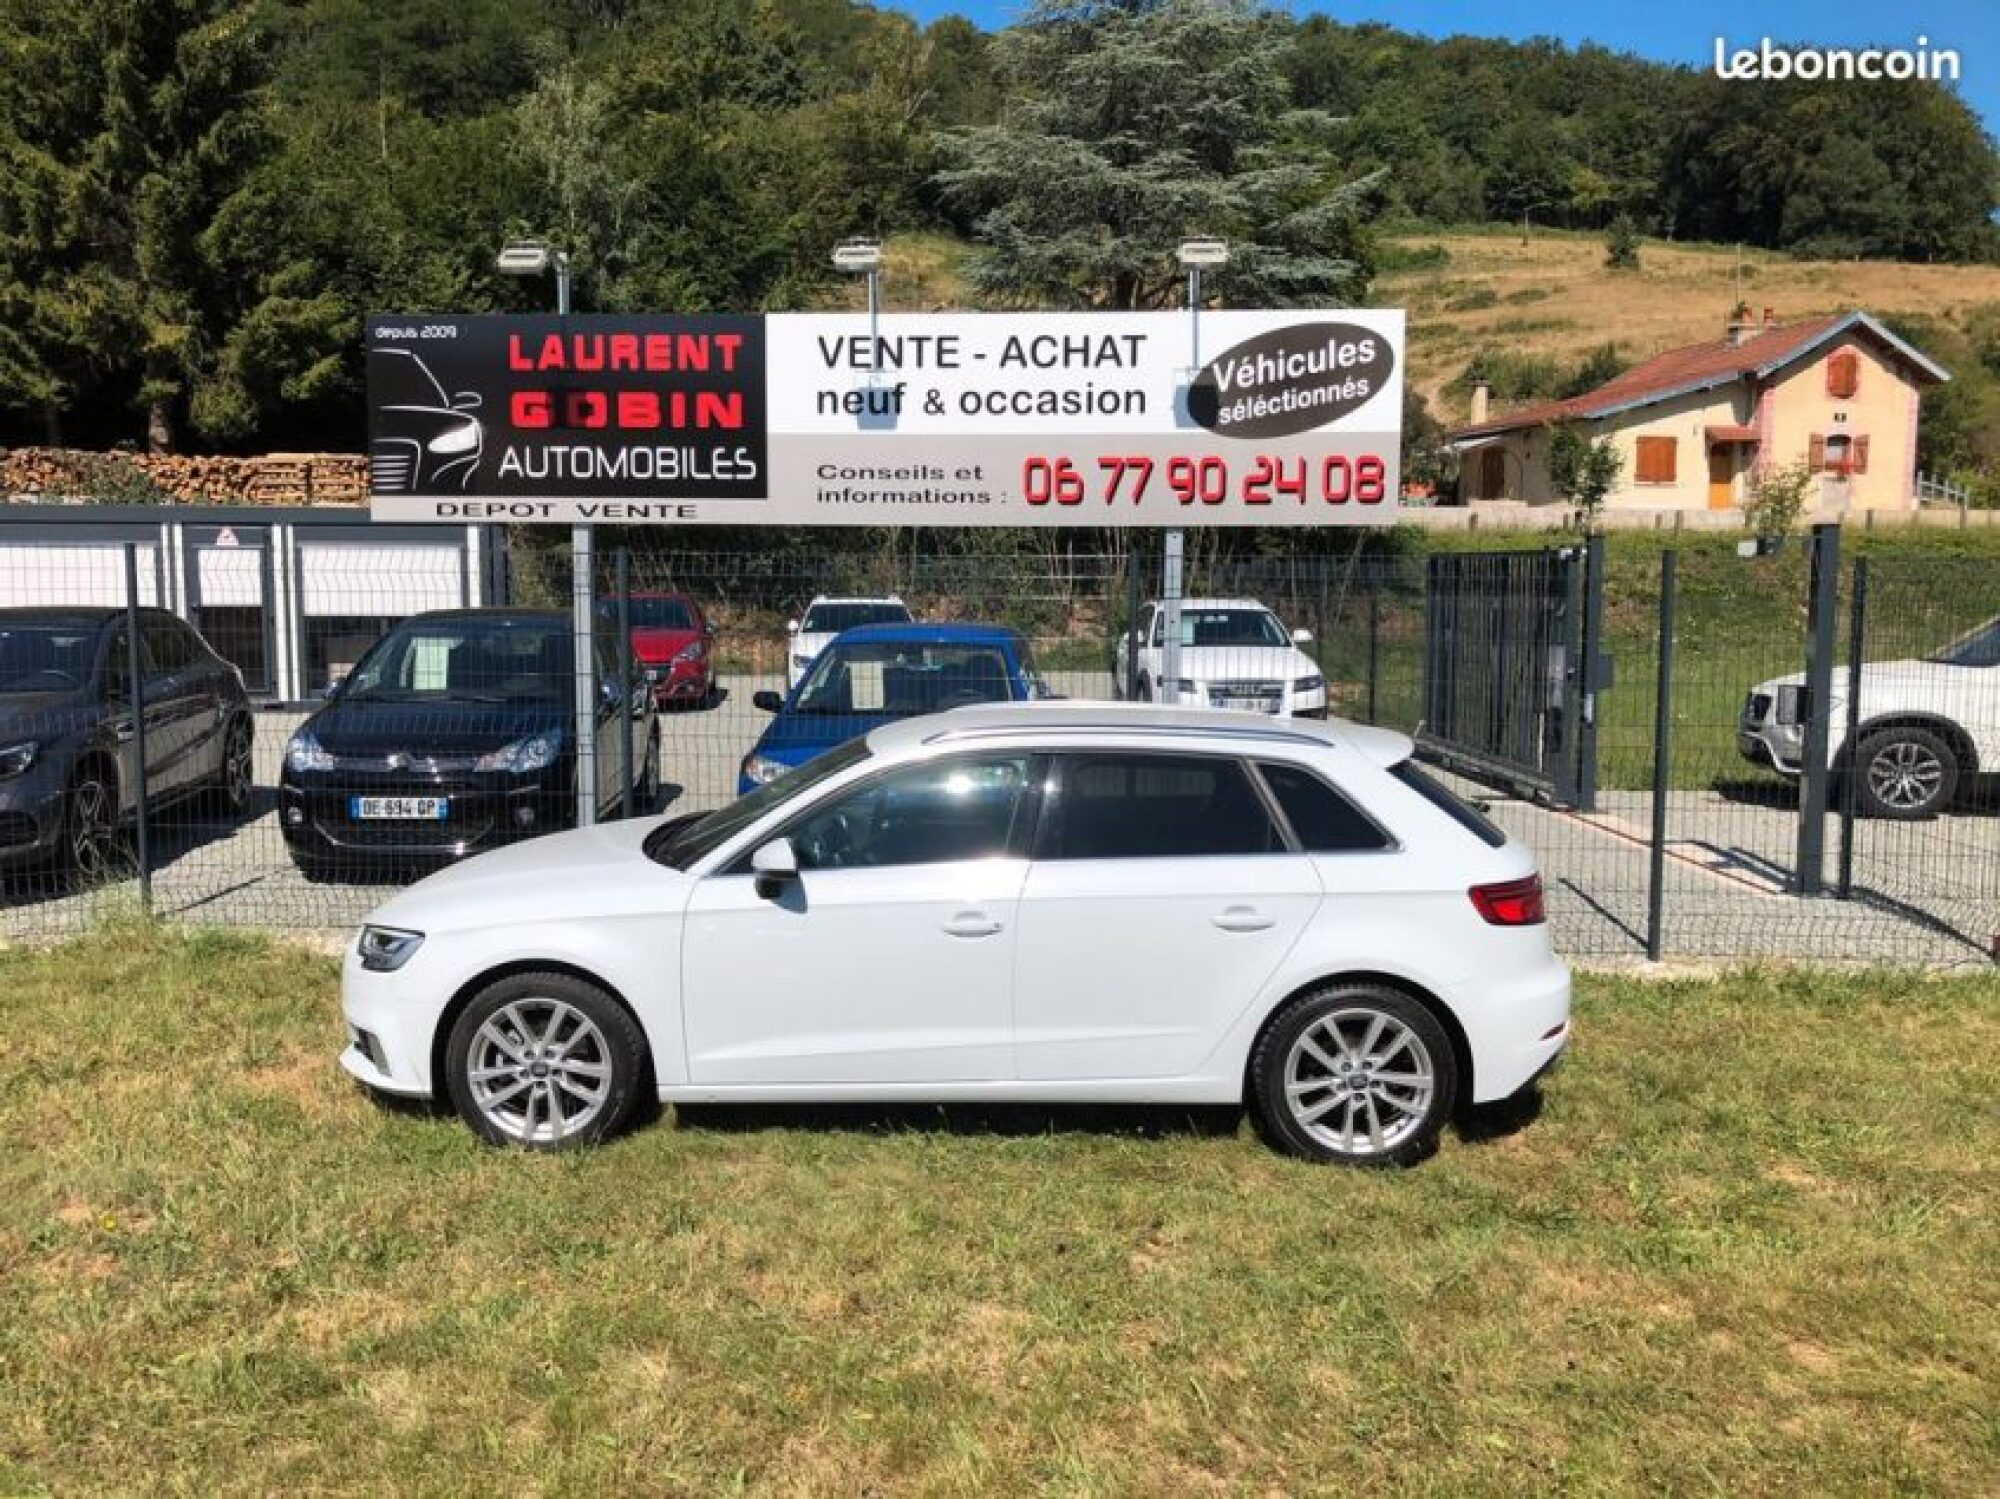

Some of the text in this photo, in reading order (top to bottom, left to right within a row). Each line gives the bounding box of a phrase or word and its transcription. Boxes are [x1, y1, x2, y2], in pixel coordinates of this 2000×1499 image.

[375, 325, 457, 340] depuis 2009
[508, 335, 744, 372] LAURENT
[818, 336, 960, 368] VENTE
[1000, 336, 1148, 369] ACHAT
[1213, 338, 1375, 393] Véhicules
[510, 392, 744, 428] GOBIN
[817, 382, 1146, 416] neuf & occasion
[1218, 376, 1371, 425] séléctionnés
[498, 446, 757, 480] AUTOMOBILES
[816, 464, 983, 480] Conseils et
[816, 487, 991, 504] informations
[1023, 456, 1386, 506] 06 77 90 24 08
[436, 503, 699, 519] DEPOT VENTE
